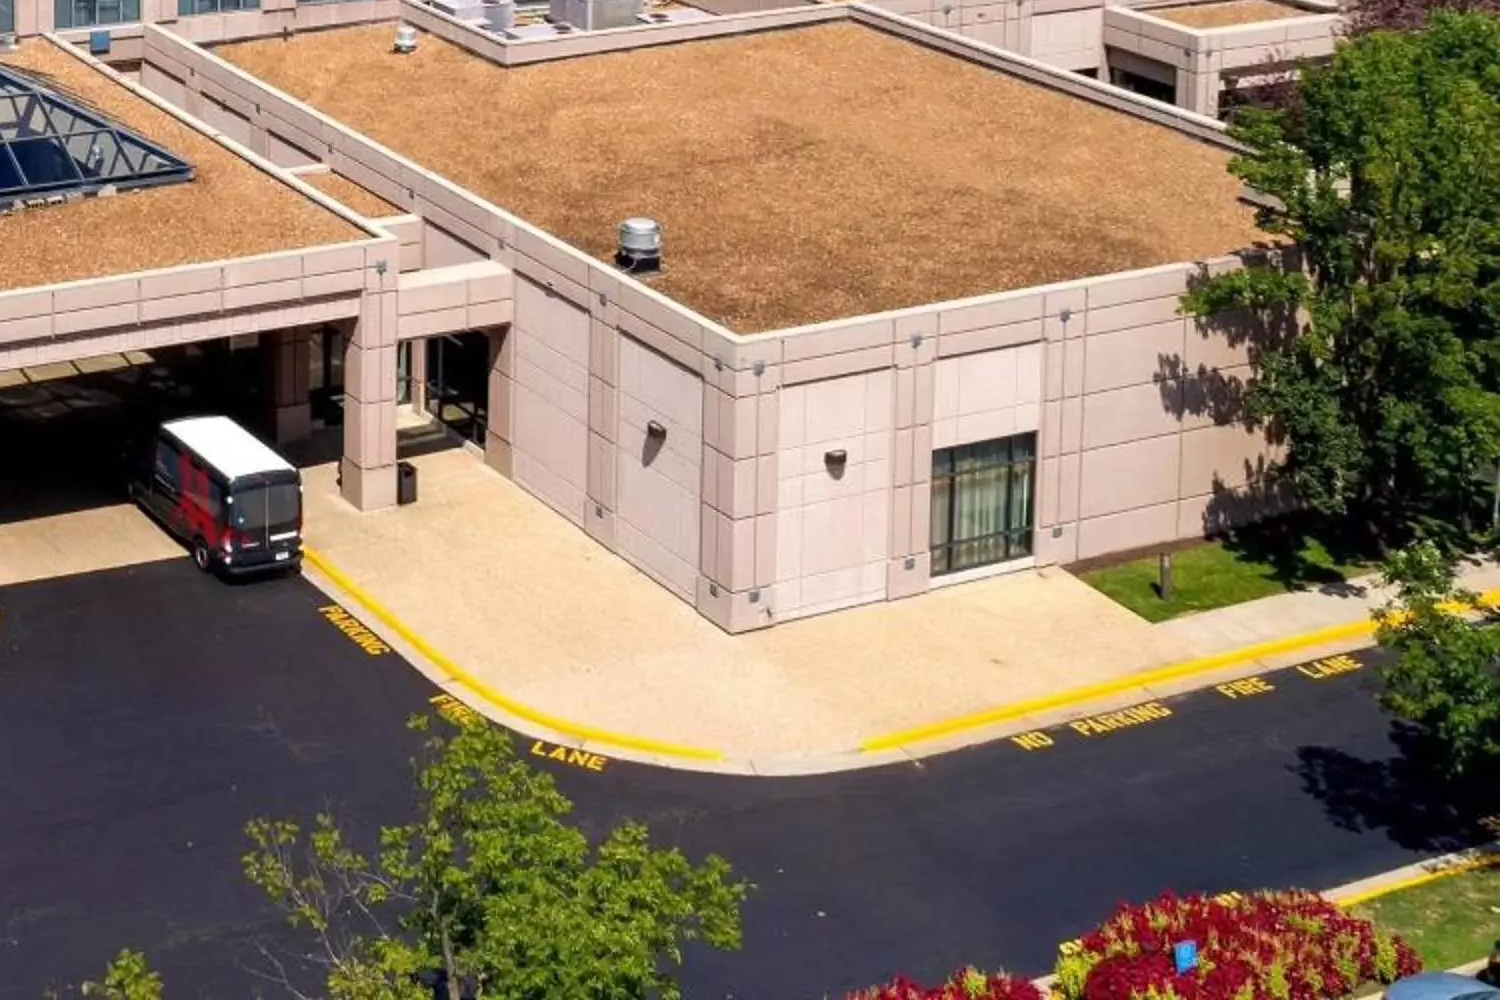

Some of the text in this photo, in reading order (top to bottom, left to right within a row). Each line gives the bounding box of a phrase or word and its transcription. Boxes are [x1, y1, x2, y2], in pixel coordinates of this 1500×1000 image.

[318, 603, 391, 656] PARKING
[531, 741, 607, 771] LANE
[1011, 655, 1364, 750] NO PARKING FIRE LANE
